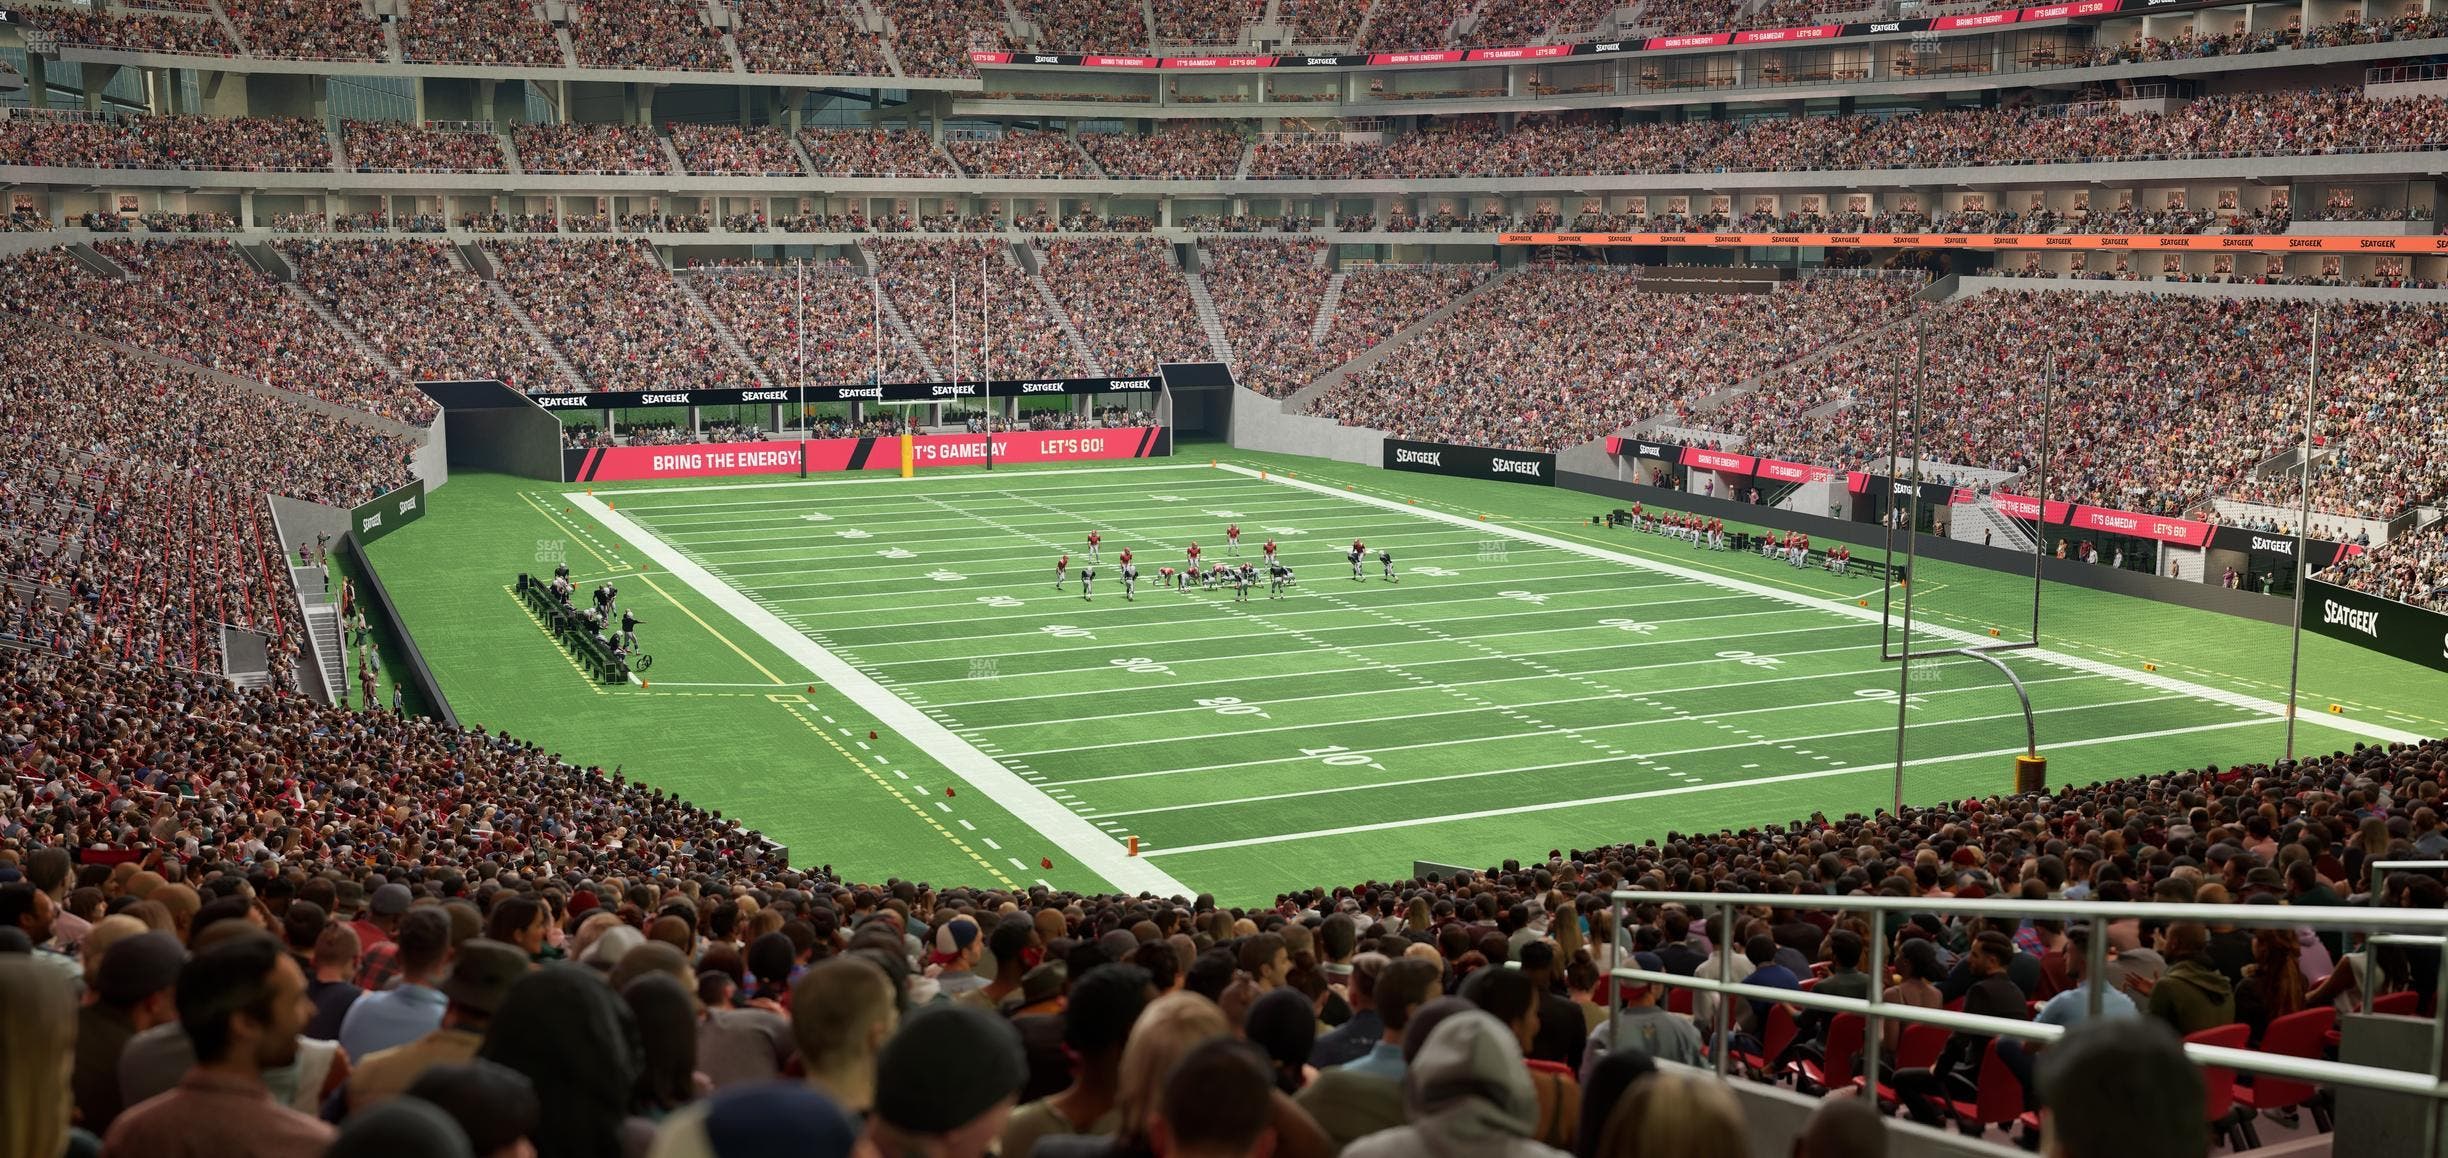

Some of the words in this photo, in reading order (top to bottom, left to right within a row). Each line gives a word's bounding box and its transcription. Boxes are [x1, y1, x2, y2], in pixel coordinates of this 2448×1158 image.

[2044, 7, 2068, 17] GAMEDAY
[2079, 4, 2090, 13] LET'S
[2091, 3, 2102, 12] GO!
[1956, 18, 1973, 26] BRING
[1974, 17, 1983, 25] THE
[1870, 23, 1899, 33] SEATGEEK
[1759, 32, 1784, 40] GAMEDAY
[1796, 30, 1811, 38] LET'S
[1681, 38, 1691, 46] THE
[1307, 57, 1337, 66] SEATGEEK
[1994, 237, 2018, 245] SEATGEEK
[2160, 238, 2189, 246] SEATGEEK
[2223, 239, 2253, 247] SEATGEEK
[2289, 239, 2322, 248] SEATGEEK
[2361, 239, 2395, 248] SEATGEEK
[932, 385, 975, 396] SEATGEEK
[1022, 382, 1064, 393] SEATGEEK
[1110, 380, 1150, 390] SEATGEEK
[642, 393, 689, 405] SEATGEEK
[742, 390, 788, 401] SEATGEEK
[839, 388, 883, 399] SEATGEEK
[538, 396, 588, 408] SEATGEEK
[940, 442, 1007, 459] GAMEDAY
[1041, 439, 1077, 455] LET'S
[1081, 438, 1104, 453] GO!
[653, 454, 702, 471] BRING
[706, 453, 735, 469] THE
[739, 450, 802, 467] ENERGY!
[1396, 448, 1441, 467] SEATGEEK
[1492, 457, 1541, 477] SEATGEEK
[1894, 482, 1921, 498] SEATGK
[2020, 503, 2046, 516] ENERG!
[2091, 513, 2104, 525] IT'S
[2104, 515, 2137, 530] GAMEDAY
[2153, 522, 2172, 536] LET'S
[2173, 525, 2187, 538] GO!
[2252, 536, 2293, 555] SEATGEEK
[2324, 599, 2379, 638] SEATGEEK
[1193, 696, 1261, 715] 20
[1298, 745, 1373, 766] 10
